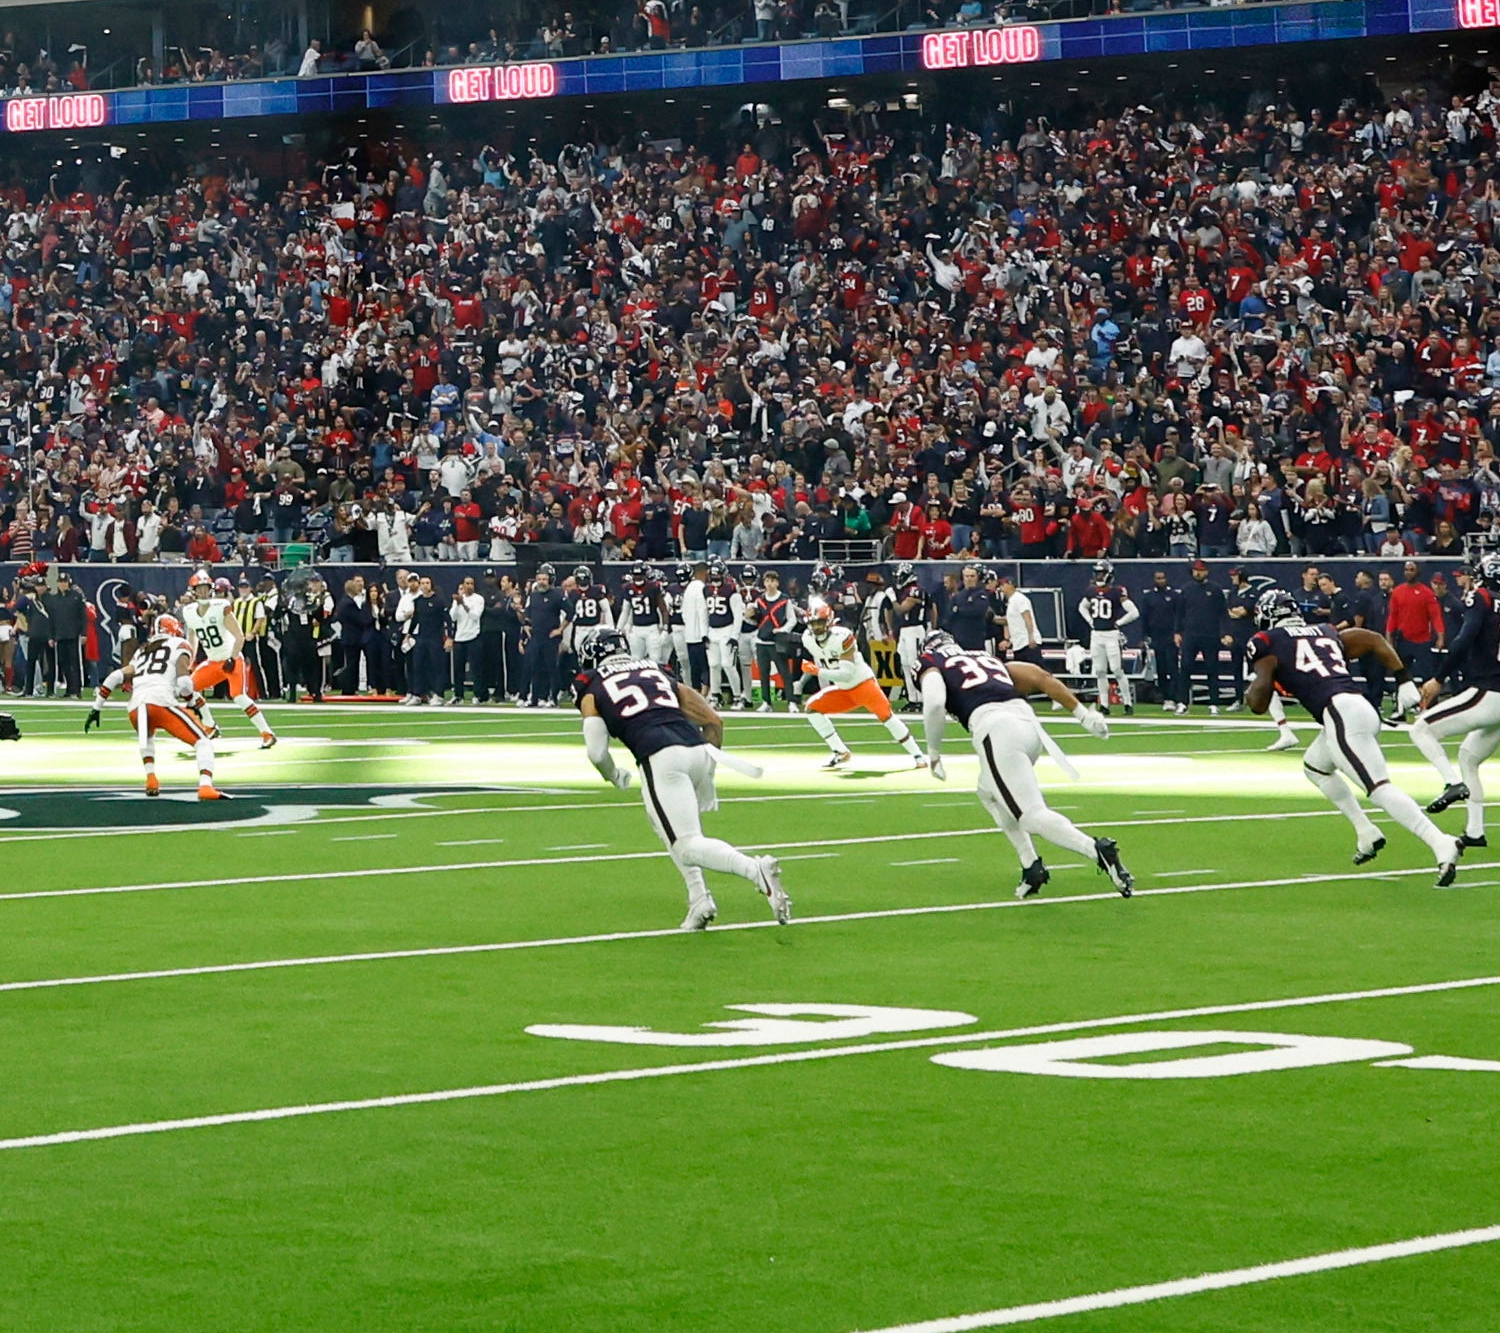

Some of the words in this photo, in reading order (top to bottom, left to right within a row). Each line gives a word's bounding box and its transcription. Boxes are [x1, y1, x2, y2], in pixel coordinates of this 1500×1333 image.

[923, 32, 972, 68] GET
[971, 27, 1038, 64] LOUD
[449, 68, 491, 102] GET
[494, 64, 554, 99] LOUD
[7, 98, 47, 131] GET
[49, 95, 104, 128] LOUD
[1187, 296, 1204, 311] 28
[576, 599, 597, 617] 48
[631, 597, 650, 615] 51
[1091, 598, 1113, 619] 30
[945, 656, 1014, 689] 39
[1295, 638, 1352, 678] 43
[602, 669, 680, 718] 53
